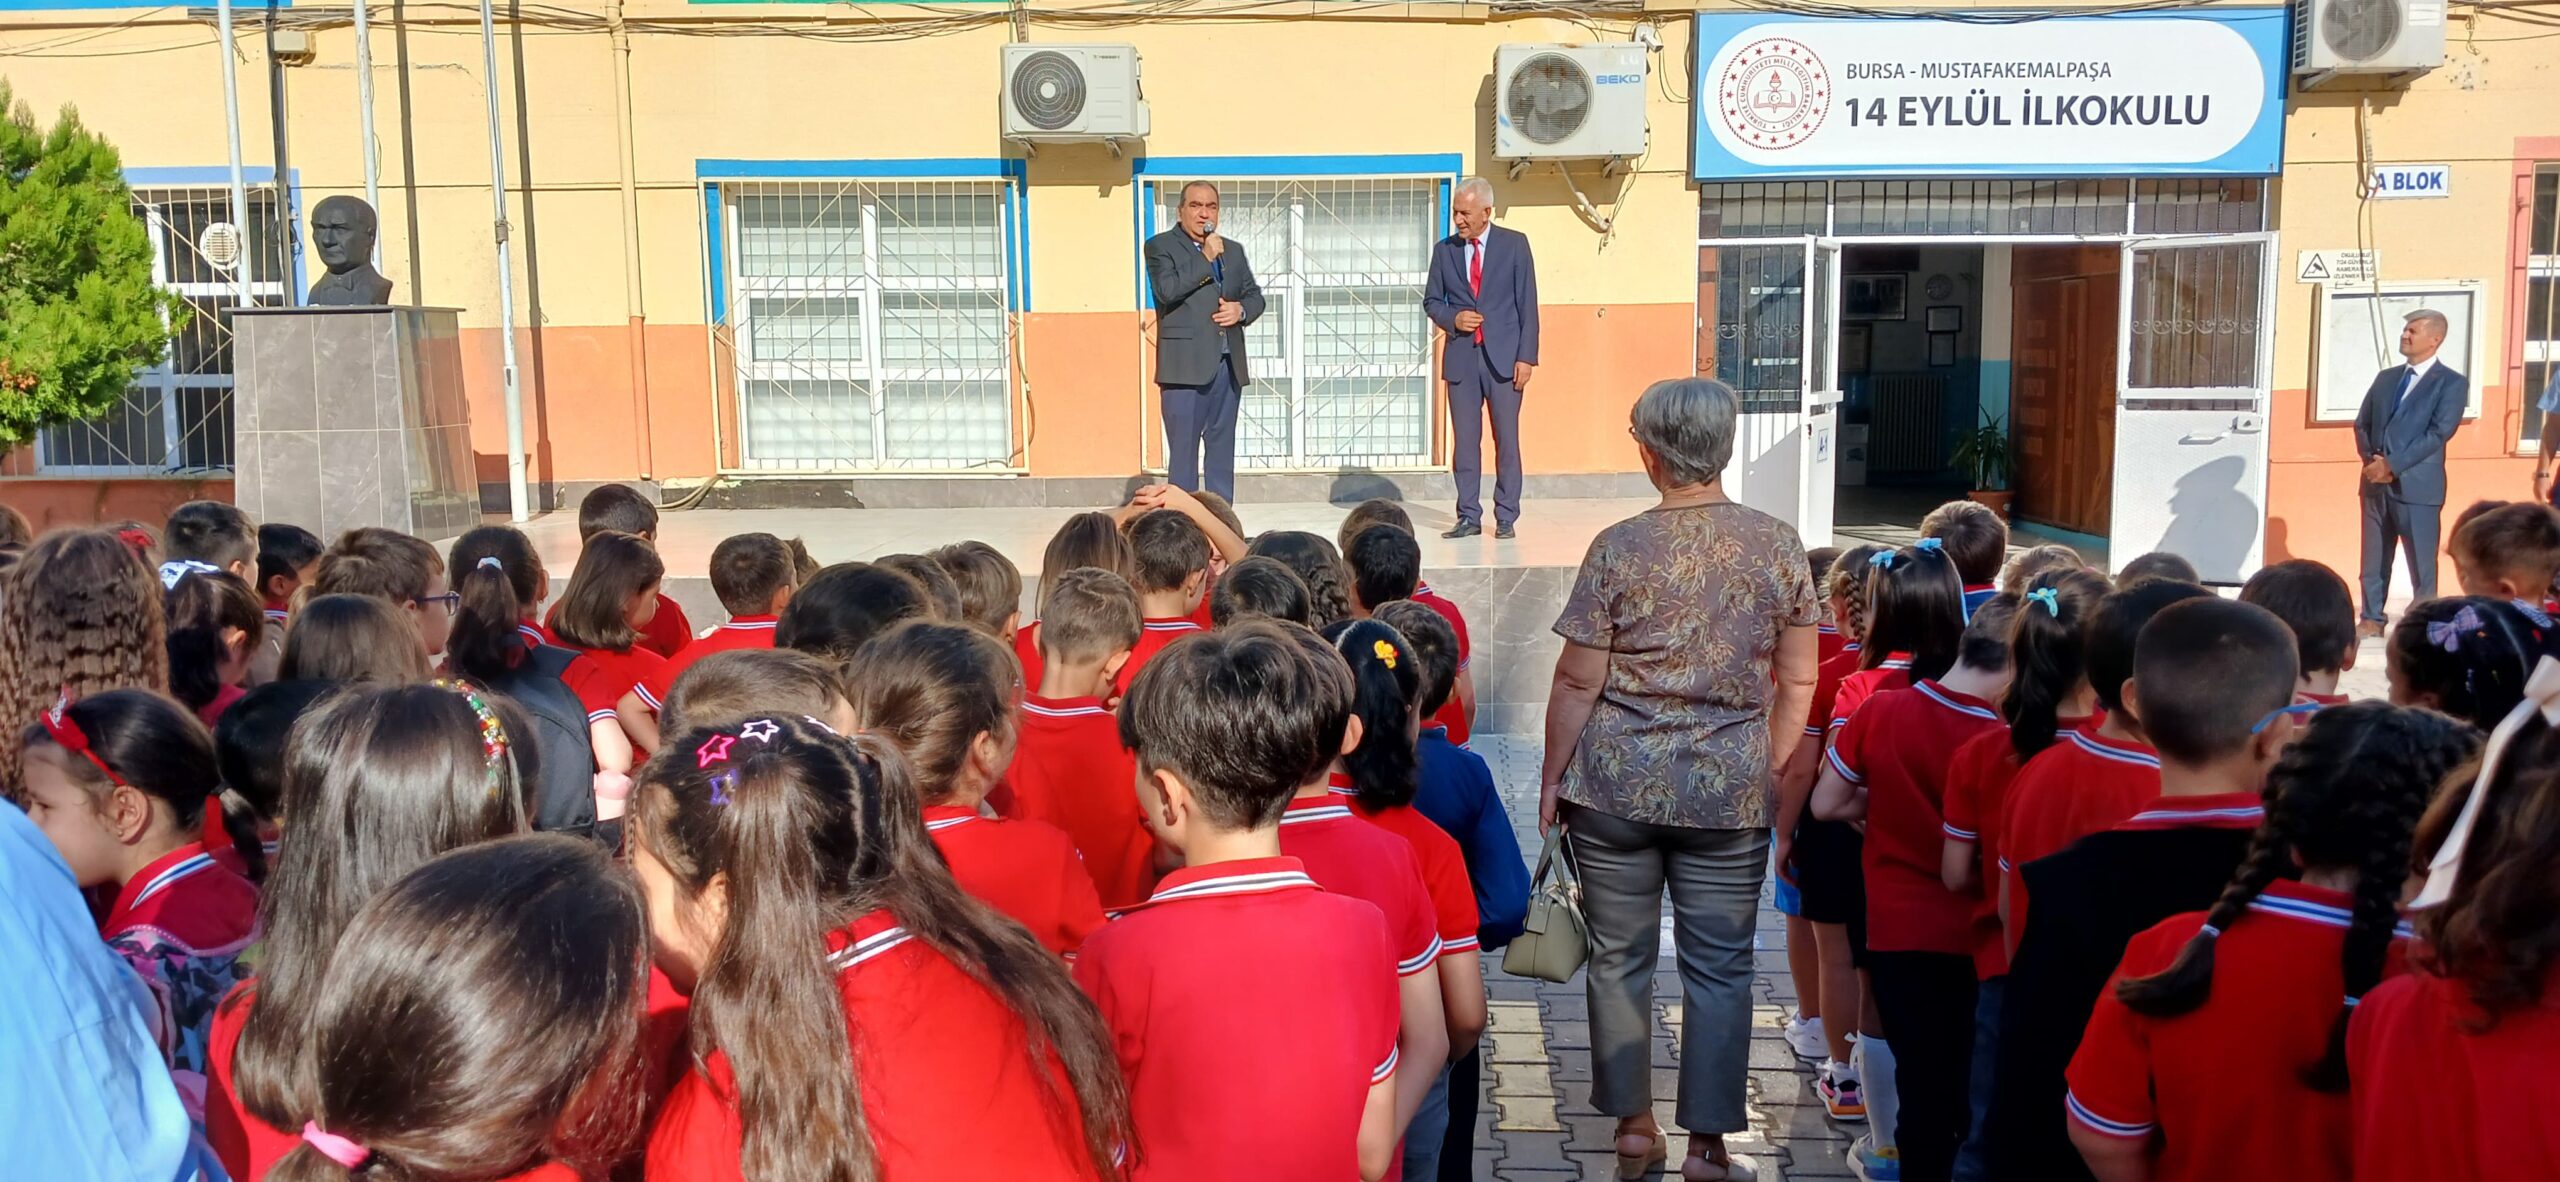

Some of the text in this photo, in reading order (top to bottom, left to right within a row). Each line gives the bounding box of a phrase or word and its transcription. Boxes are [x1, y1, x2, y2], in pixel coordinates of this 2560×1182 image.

[1596, 75, 1641, 84] BEKO
[1740, 59, 1771, 103] CUMHURİYETİ
[1846, 63, 1906, 79] BURSA
[1921, 62, 2112, 82] MUSTAFAKEMALPAŞA
[1845, 88, 2210, 127] 14 EYLÜL İLKOKULU
[2393, 171, 2443, 190] BLOK
